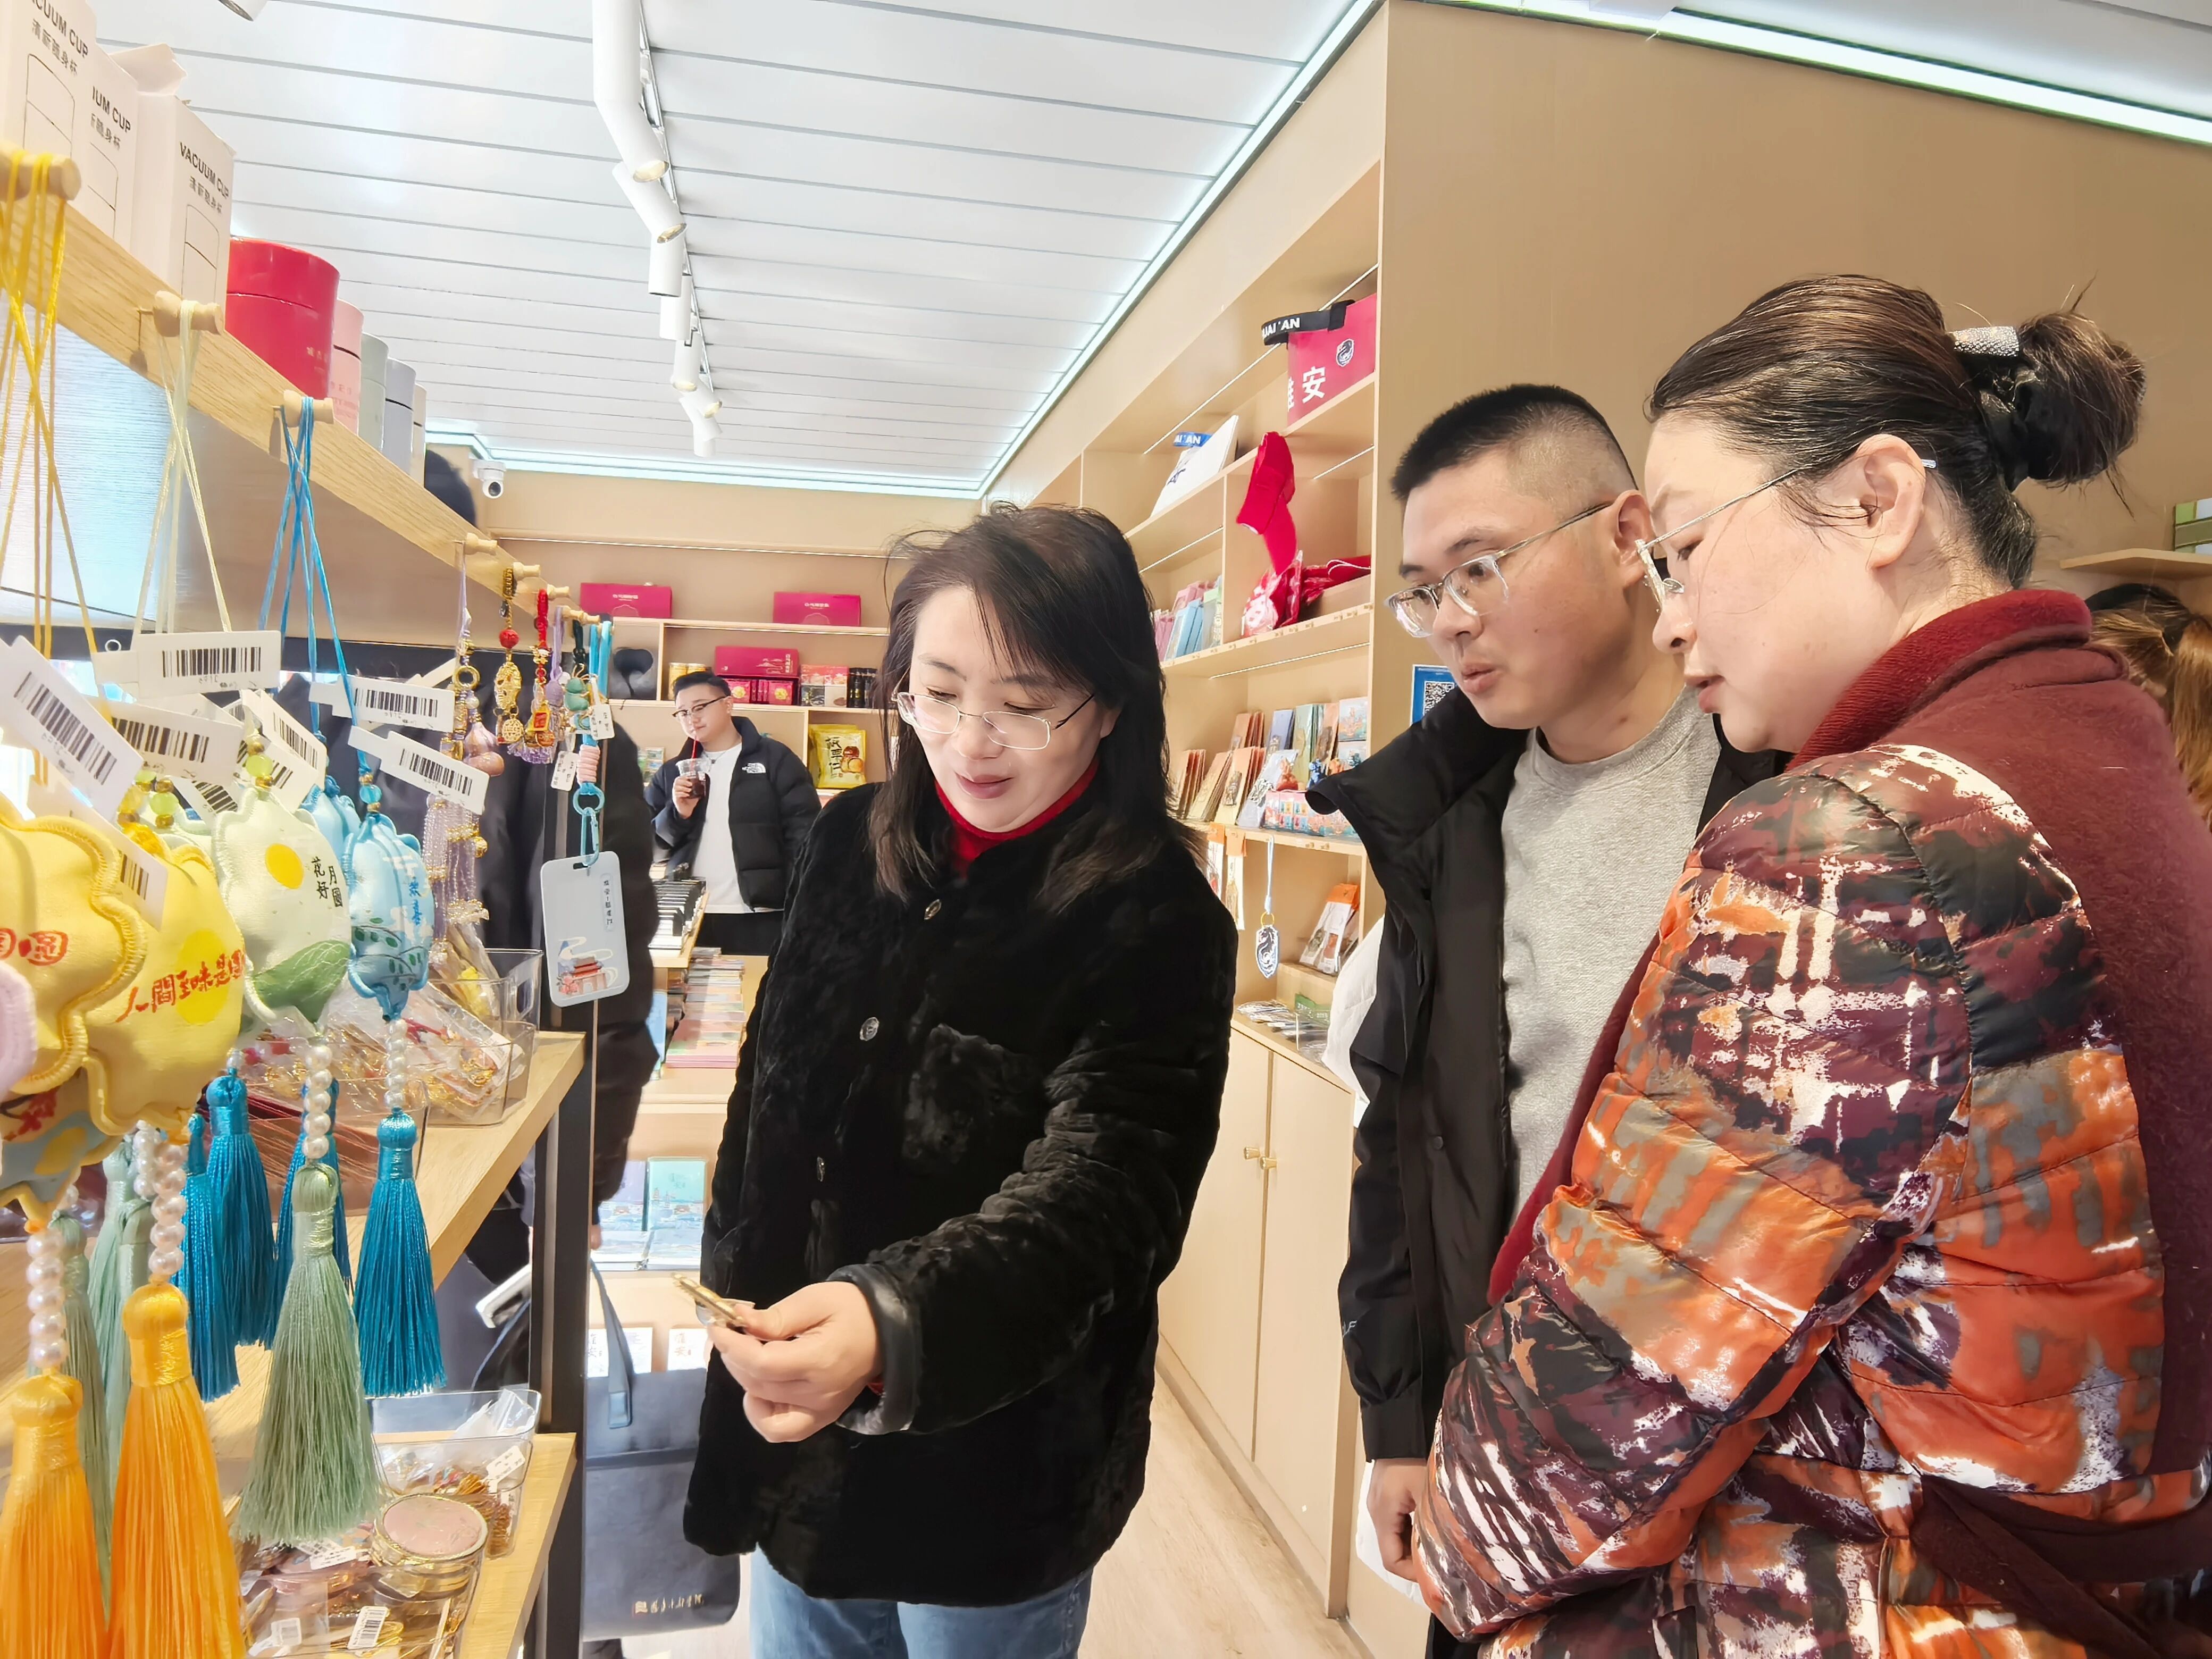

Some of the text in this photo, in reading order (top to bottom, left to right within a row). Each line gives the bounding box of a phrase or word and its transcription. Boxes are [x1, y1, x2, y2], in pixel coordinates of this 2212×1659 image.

[32, 0, 88, 58] CUUM CUP
[112, 107, 131, 133] CUP
[180, 141, 229, 199] VACUUM CUP
